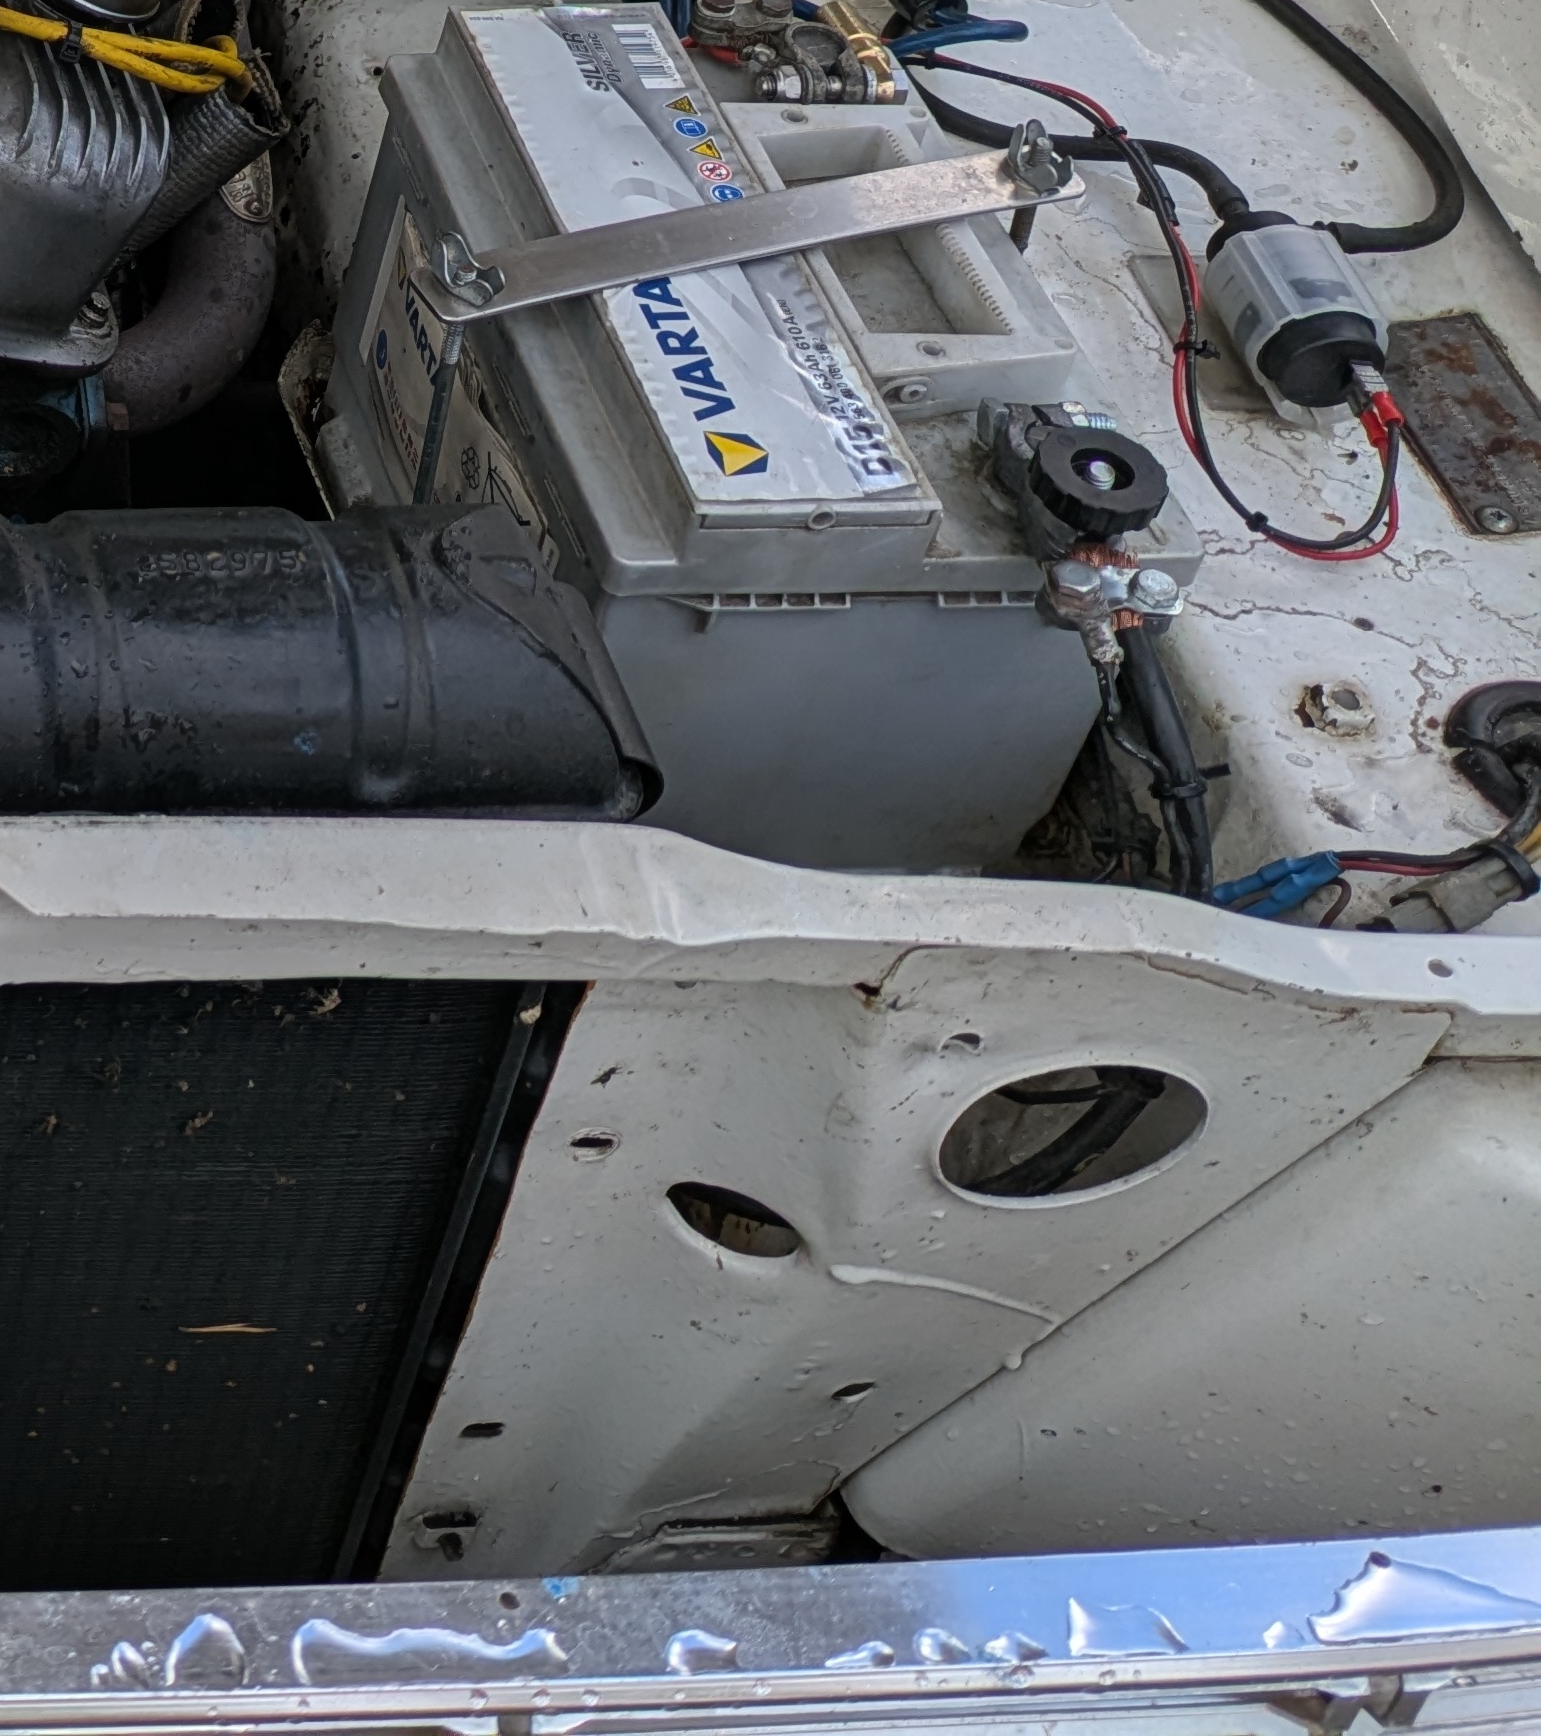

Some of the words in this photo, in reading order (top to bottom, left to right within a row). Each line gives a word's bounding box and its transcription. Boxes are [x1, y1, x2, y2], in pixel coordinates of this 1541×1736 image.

[562, 31, 610, 92] SILVER
[588, 32, 623, 84] Dynamic
[404, 276, 441, 386] VART
[632, 276, 736, 422] VARTA
[804, 354, 834, 392] 63Ah
[823, 394, 849, 422] 12V
[842, 424, 894, 476] D15
